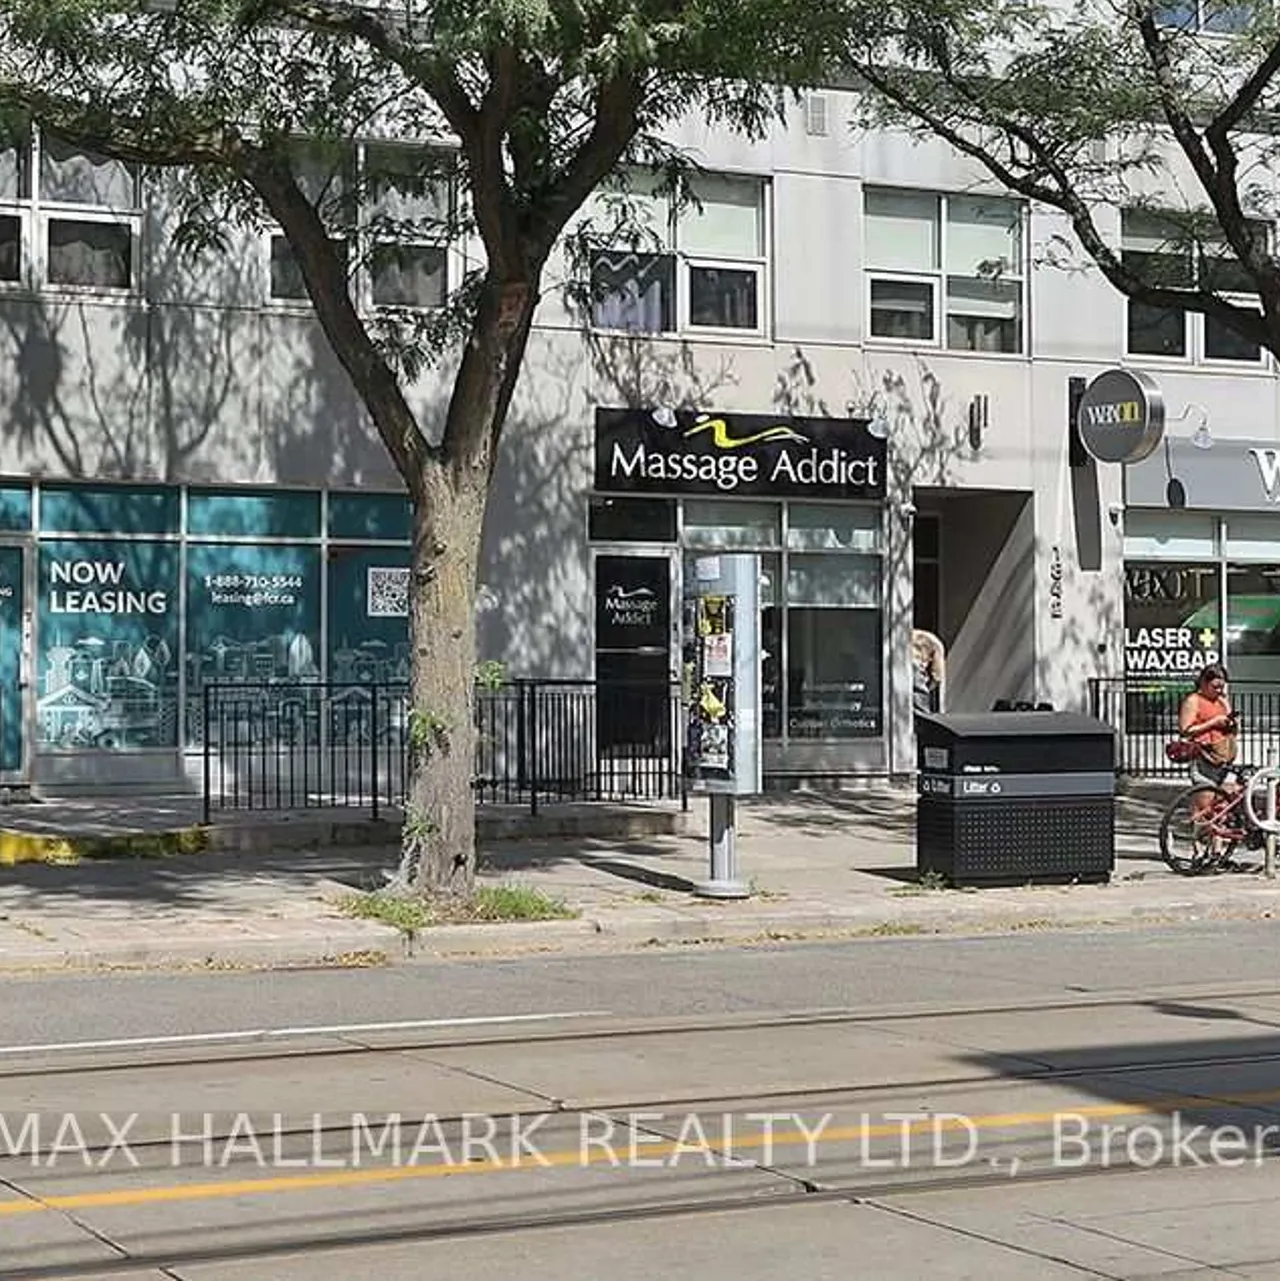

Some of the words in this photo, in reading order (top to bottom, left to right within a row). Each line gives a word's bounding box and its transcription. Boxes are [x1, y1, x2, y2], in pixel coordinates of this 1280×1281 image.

[611, 442, 759, 490] Massage
[771, 448, 879, 487] Addict
[50, 561, 125, 585] NOW
[50, 591, 167, 614] LEASING
[1125, 628, 1192, 648] LASER
